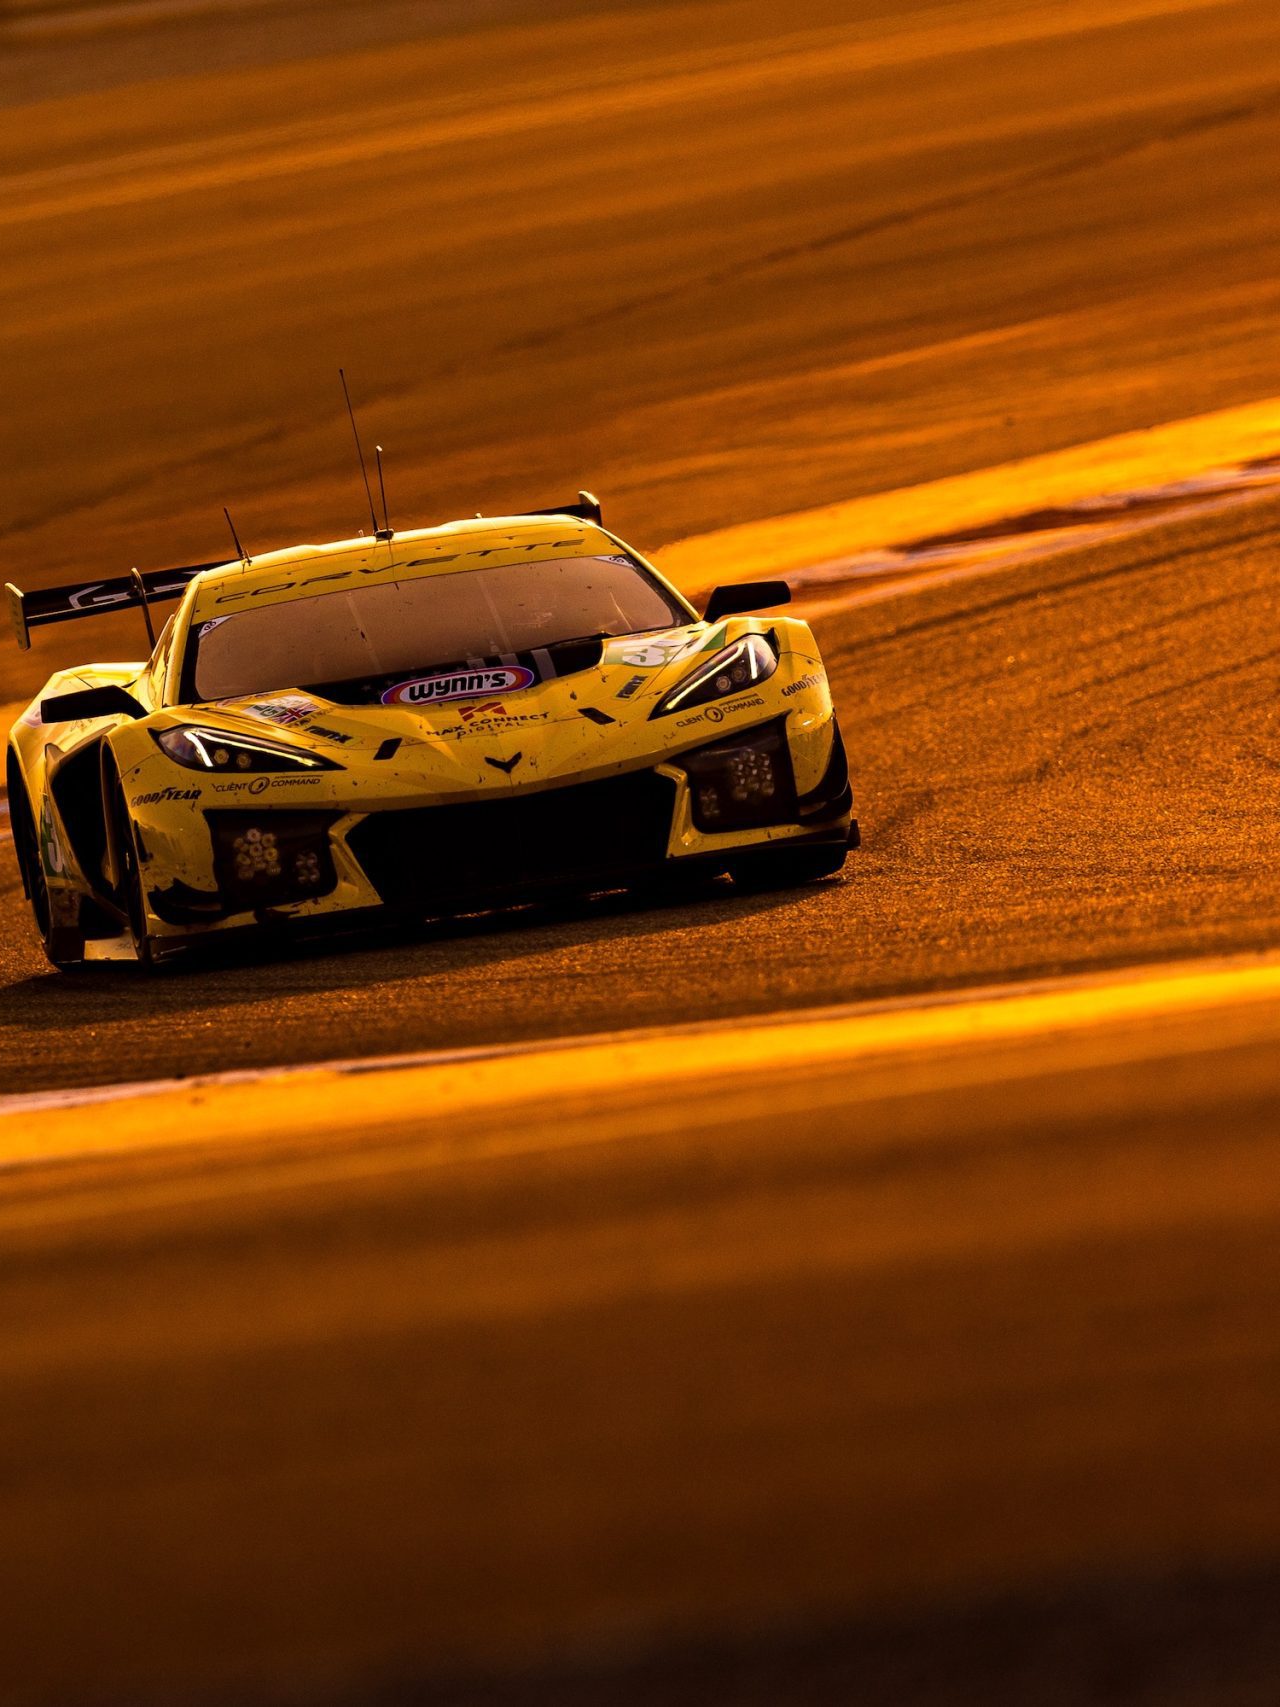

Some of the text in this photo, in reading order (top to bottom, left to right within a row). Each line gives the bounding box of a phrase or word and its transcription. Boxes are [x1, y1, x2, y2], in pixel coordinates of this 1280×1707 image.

[216, 538, 585, 604] CORVETTE
[468, 712, 550, 728] CONNECT
[676, 715, 705, 728] CLIENT
[723, 697, 765, 714] COMMAND
[215, 782, 249, 792] CLIENT
[270, 777, 321, 788] COMMAND
